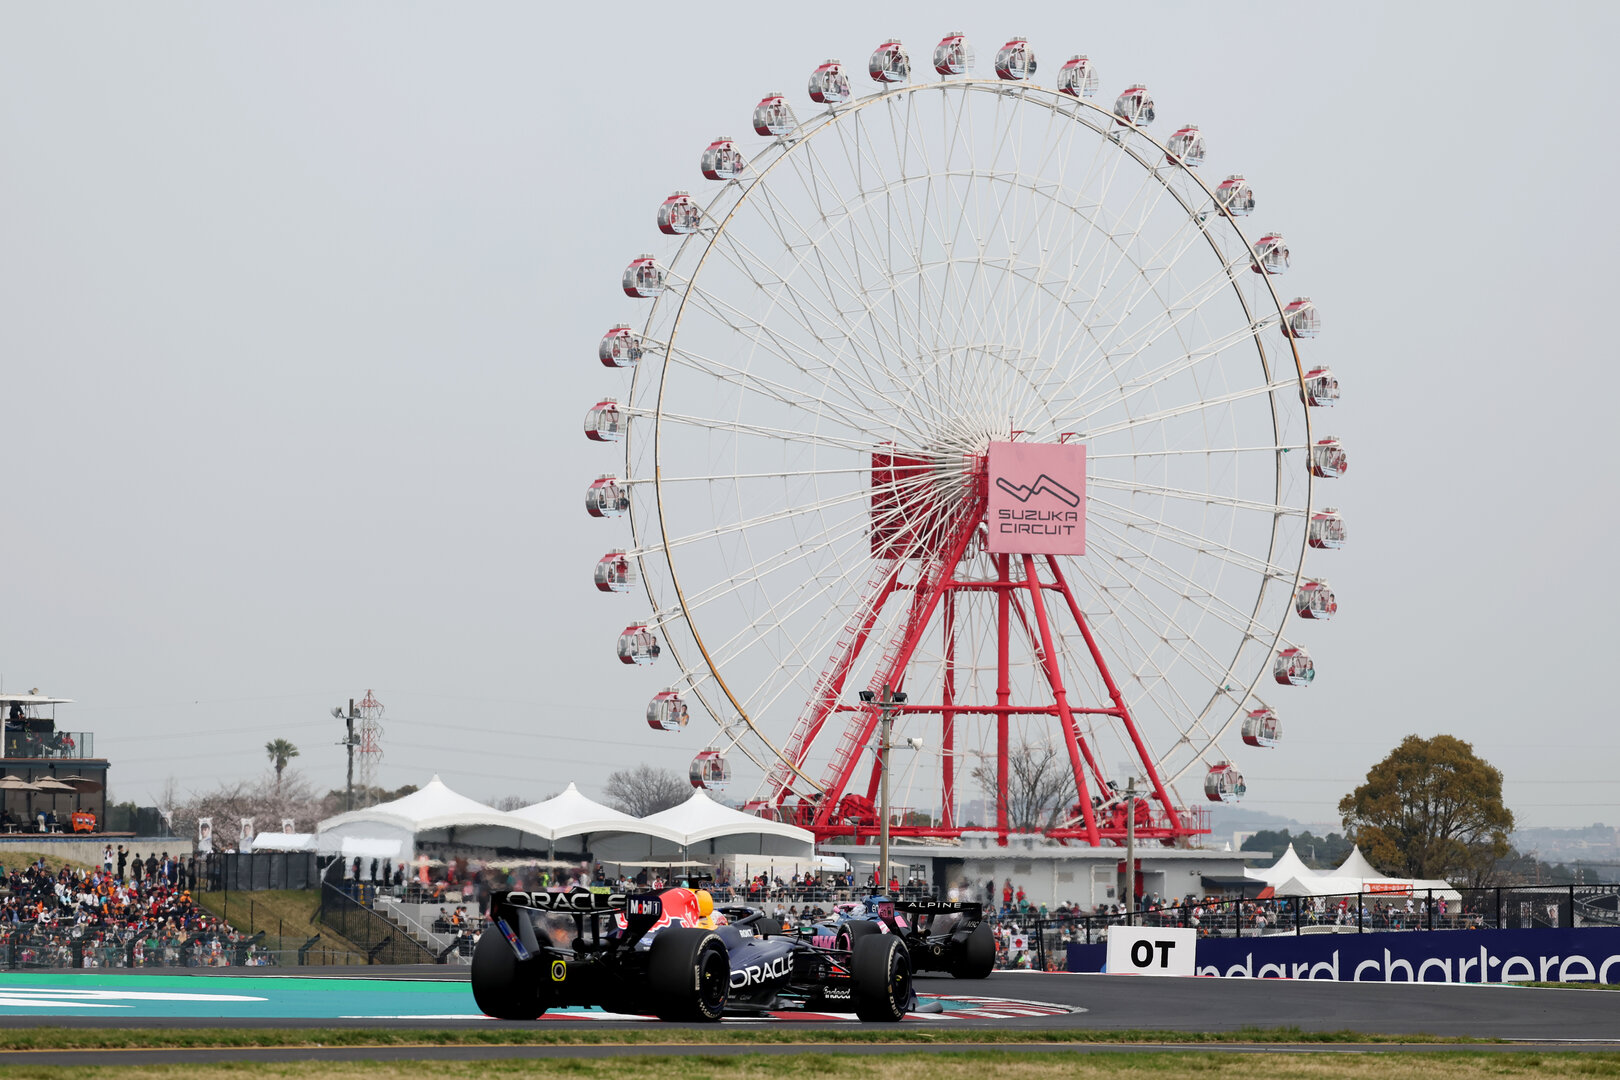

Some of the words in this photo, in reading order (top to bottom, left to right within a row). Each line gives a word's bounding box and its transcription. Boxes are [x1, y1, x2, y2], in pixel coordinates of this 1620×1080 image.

[998, 509, 1078, 522] SUZUKA
[1000, 523, 1076, 536] CIRCUIT
[506, 891, 627, 910] ORACLE
[630, 899, 652, 915] Mobil
[1130, 939, 1176, 968] OT
[729, 952, 794, 989] ORACLE
